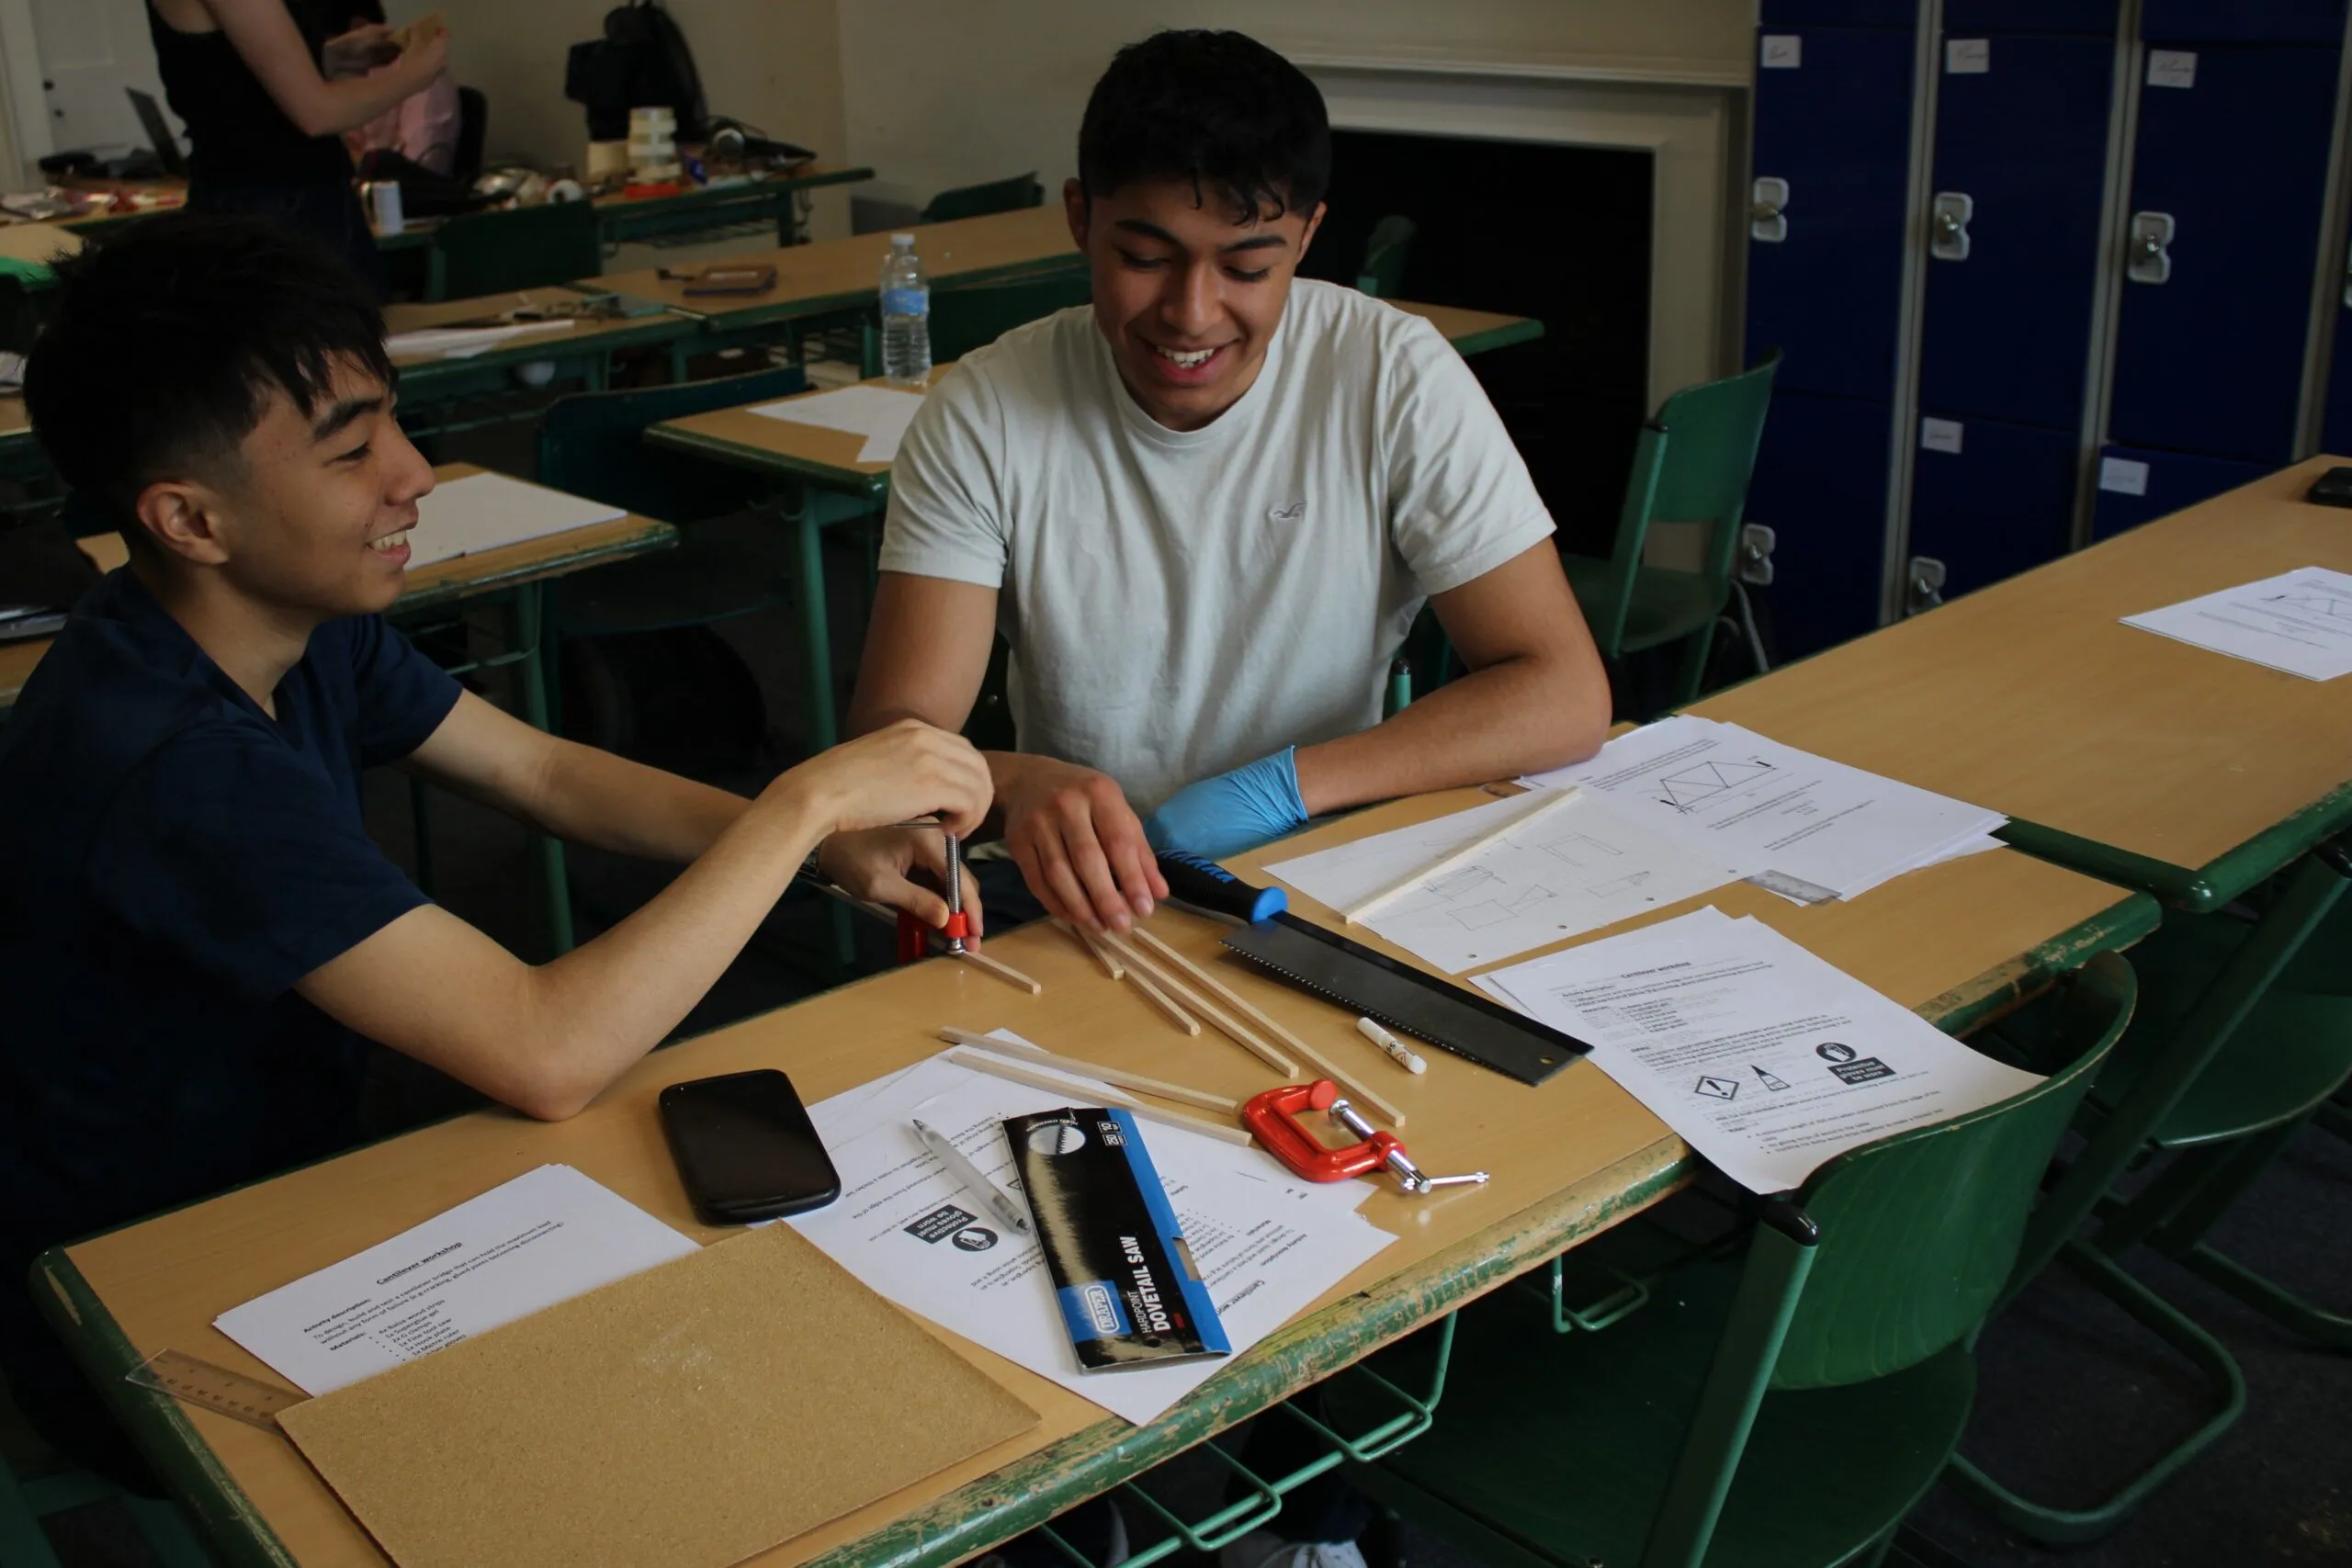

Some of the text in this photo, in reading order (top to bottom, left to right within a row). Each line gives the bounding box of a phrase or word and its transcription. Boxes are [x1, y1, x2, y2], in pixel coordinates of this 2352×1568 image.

[1836, 1061, 1875, 1073] Protective
[917, 1210, 963, 1236] gloves must
[917, 1217, 937, 1229] worn
[929, 1216, 968, 1238] Protective
[376, 1242, 462, 1285] Cantilever workshop
[1120, 1236, 1171, 1332] DOVETAIL SAW
[1231, 1280, 1265, 1304] Cantilever
[407, 1308, 427, 1321] wood
[425, 1299, 446, 1311] strips
[1091, 1289, 1116, 1328] DRAPER
[1127, 1291, 1152, 1334] HARDPOINT
[303, 1318, 331, 1333] Activity
[393, 1315, 428, 1335] Superglue
